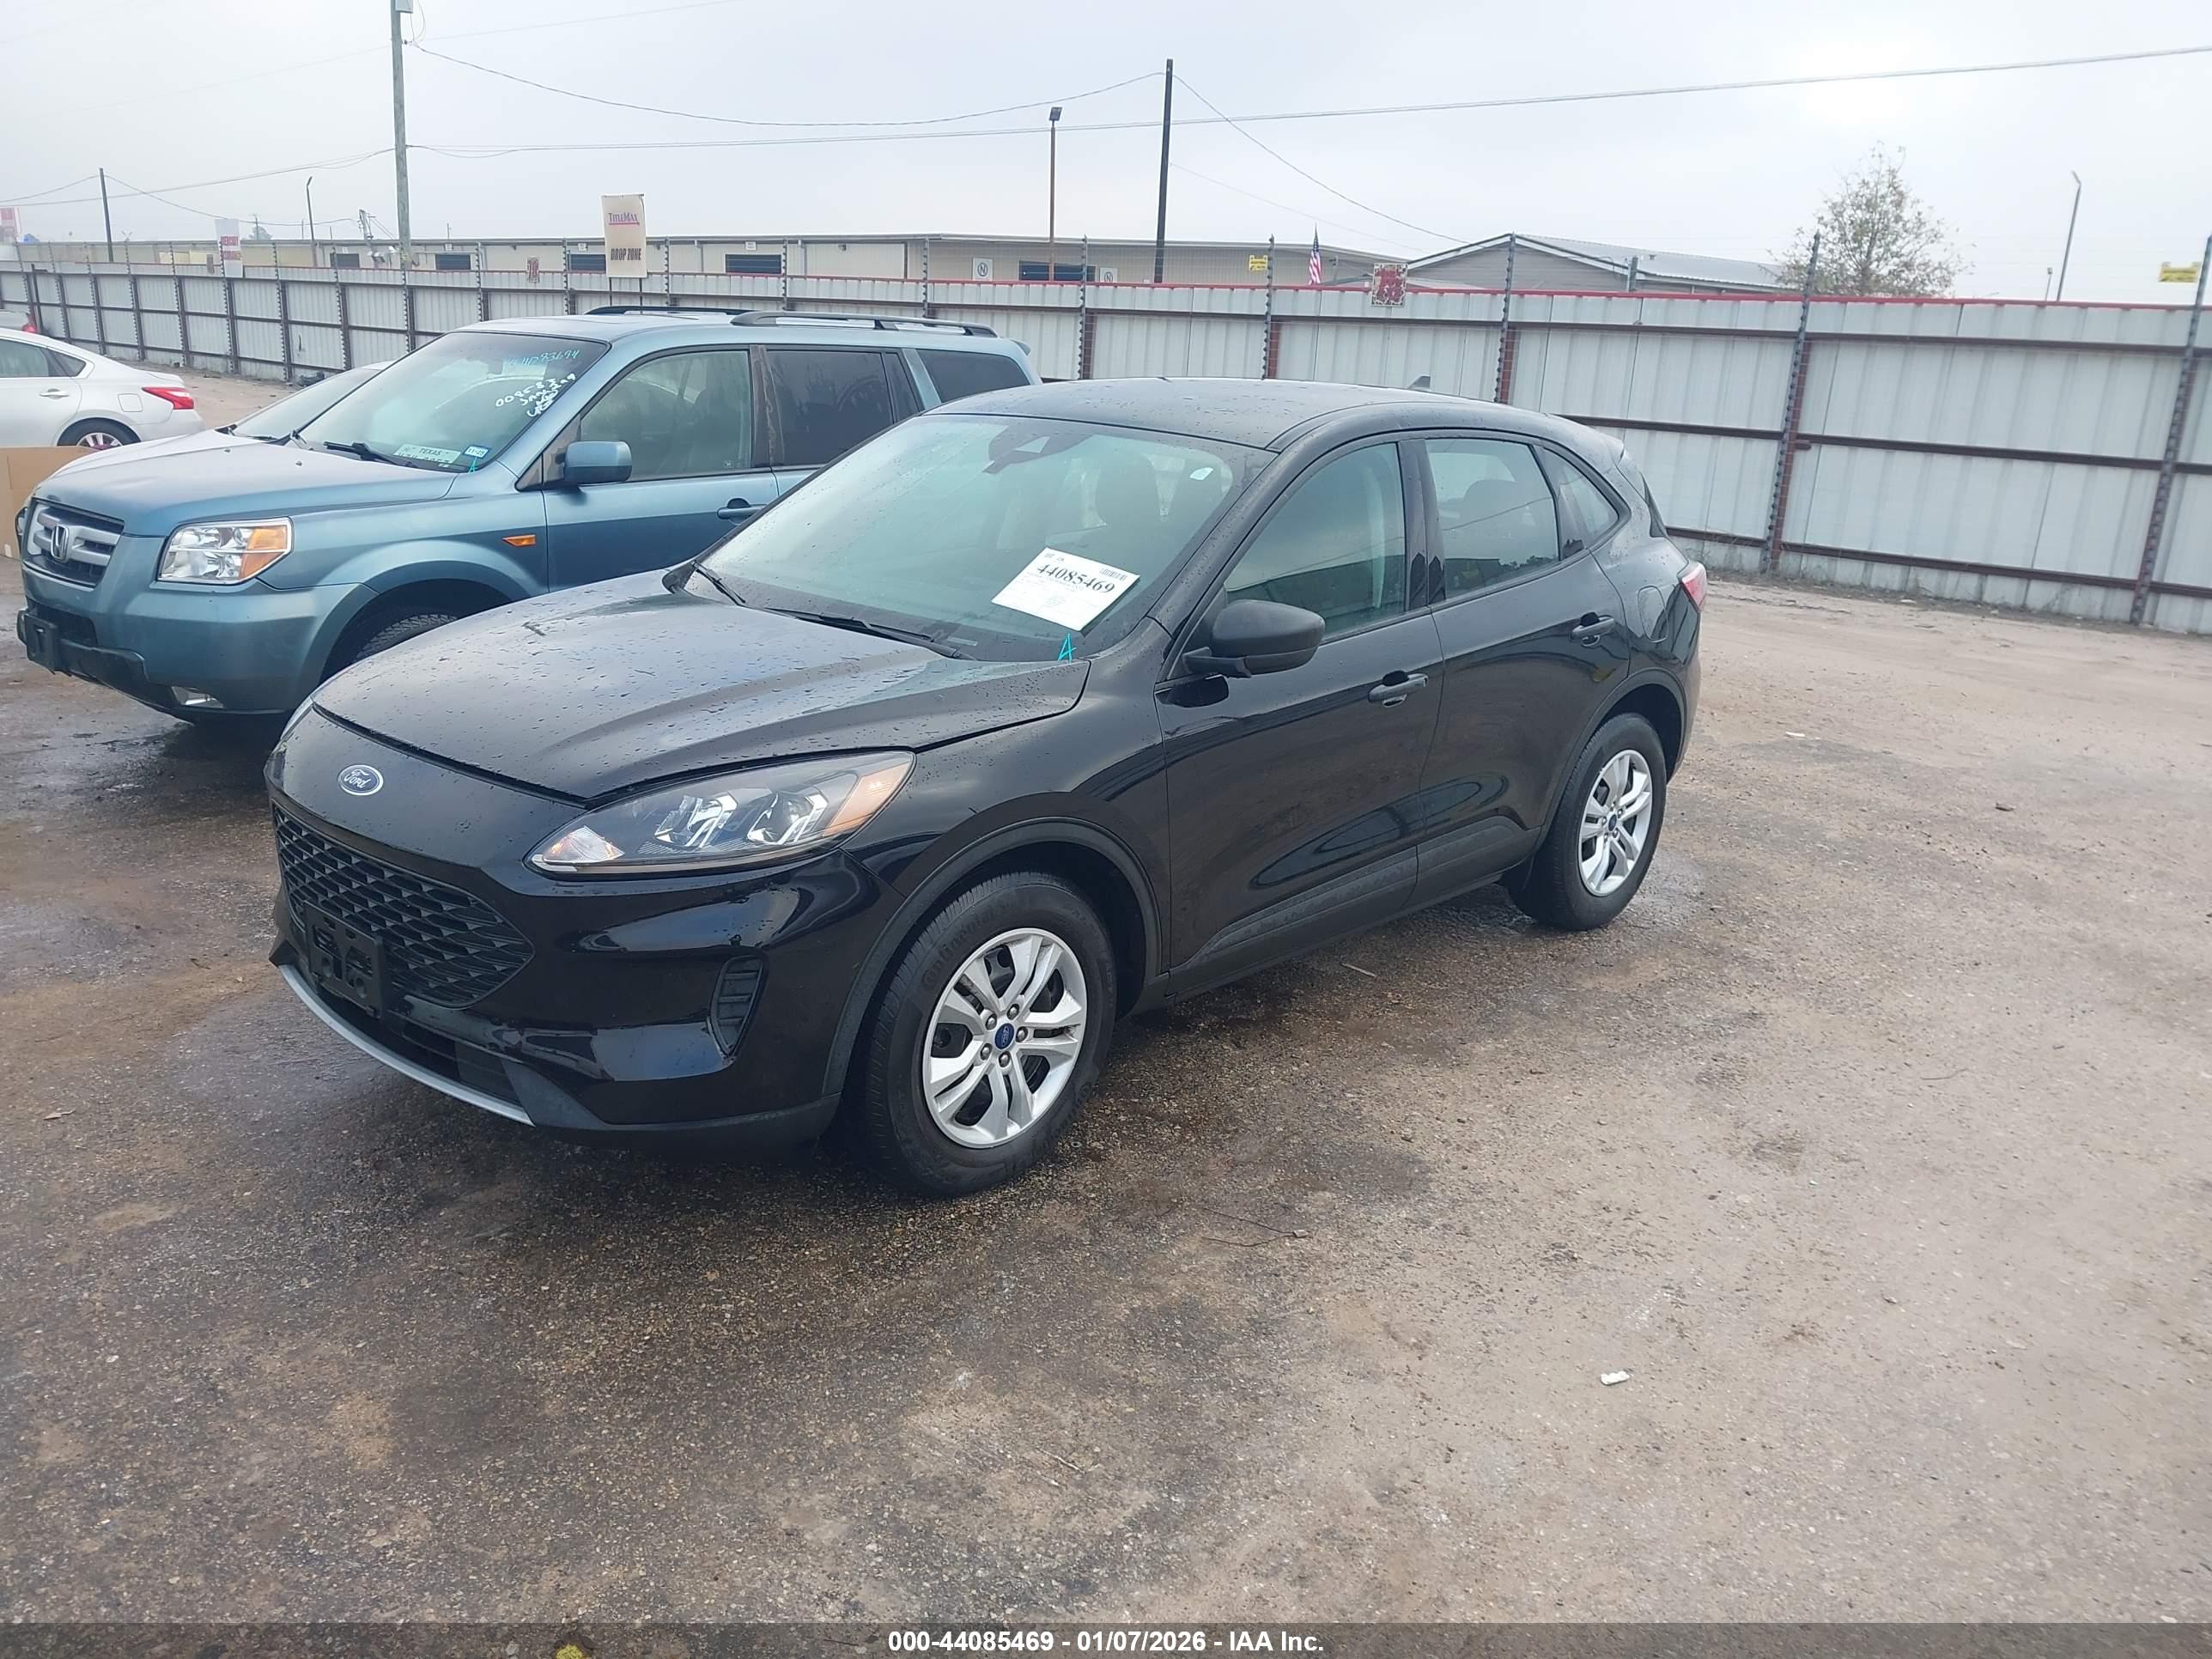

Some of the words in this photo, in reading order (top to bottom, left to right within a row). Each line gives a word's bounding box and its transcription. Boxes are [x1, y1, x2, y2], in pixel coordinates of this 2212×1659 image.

[611, 248, 626, 261] DROP
[628, 248, 641, 261] ZONE
[419, 447, 442, 456] TEXAS
[1037, 563, 1115, 593] 44085469
[343, 769, 371, 788] Ford
